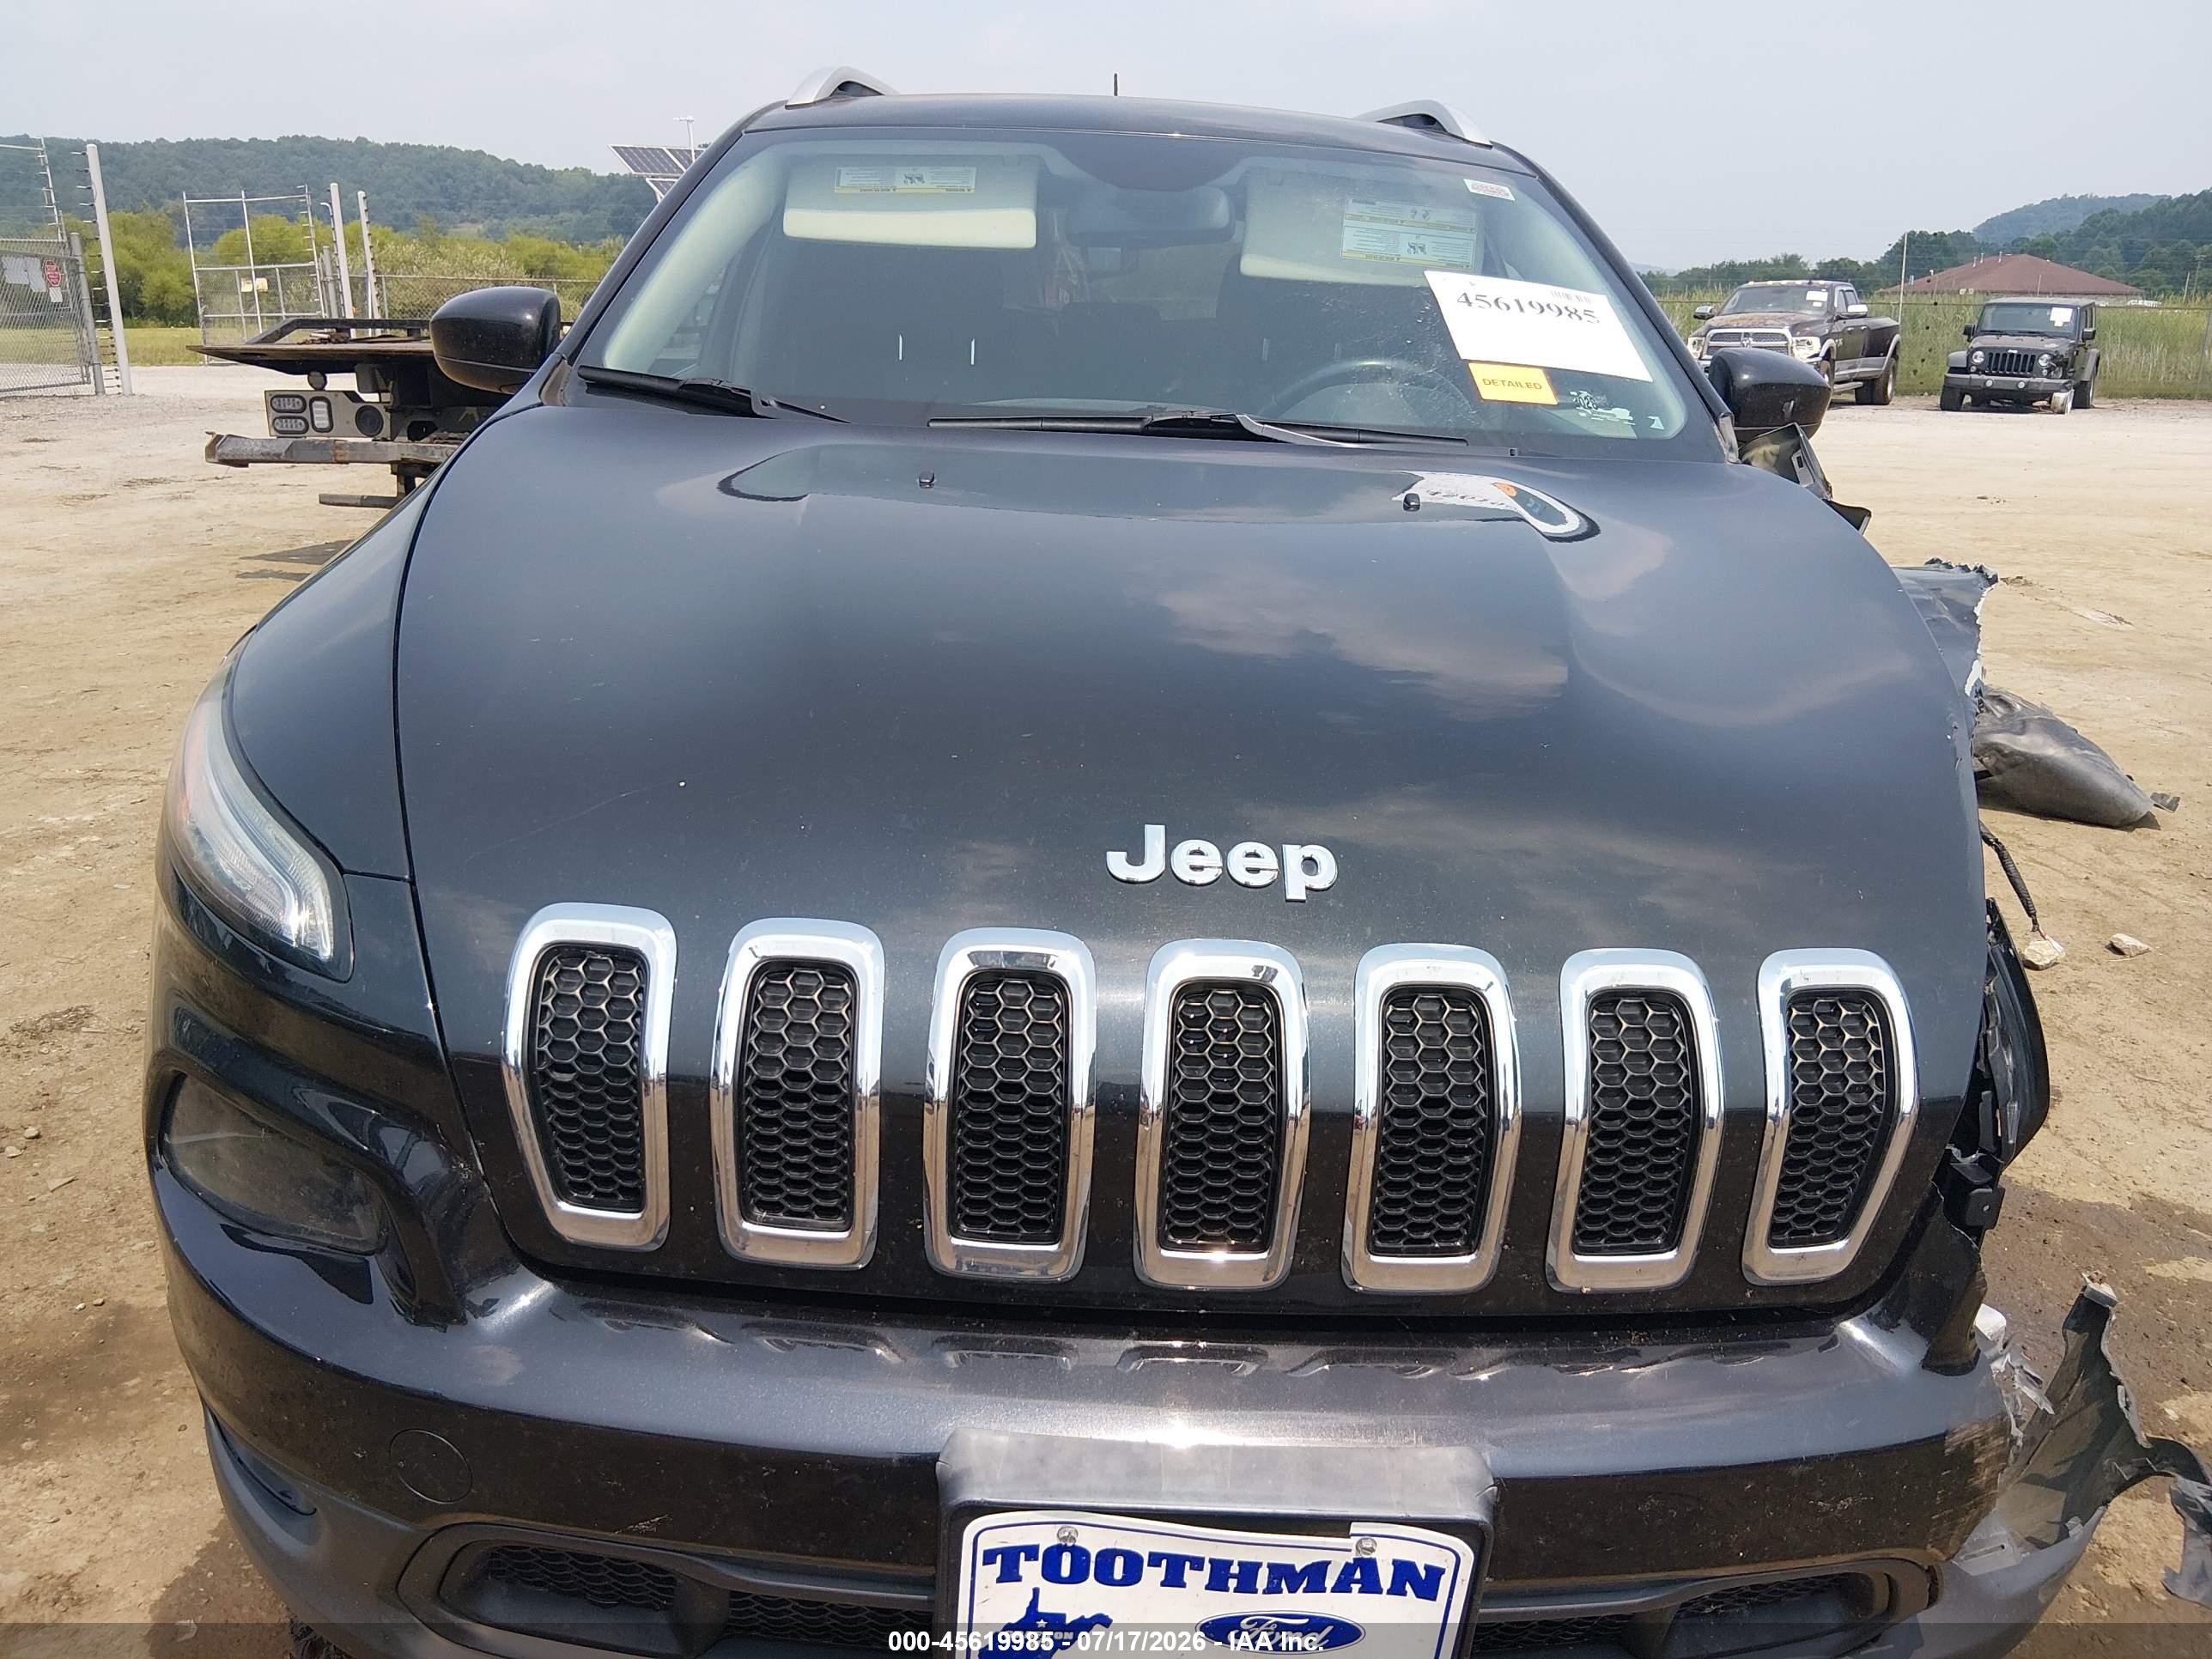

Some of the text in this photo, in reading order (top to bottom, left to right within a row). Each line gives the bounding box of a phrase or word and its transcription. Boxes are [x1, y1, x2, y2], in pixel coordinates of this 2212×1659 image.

[1457, 292, 1601, 324] 45619985
[1482, 378, 1543, 391] DETAILED
[1106, 824, 1338, 902] Jeep
[982, 1543, 1447, 1602] TOOTHMAN
